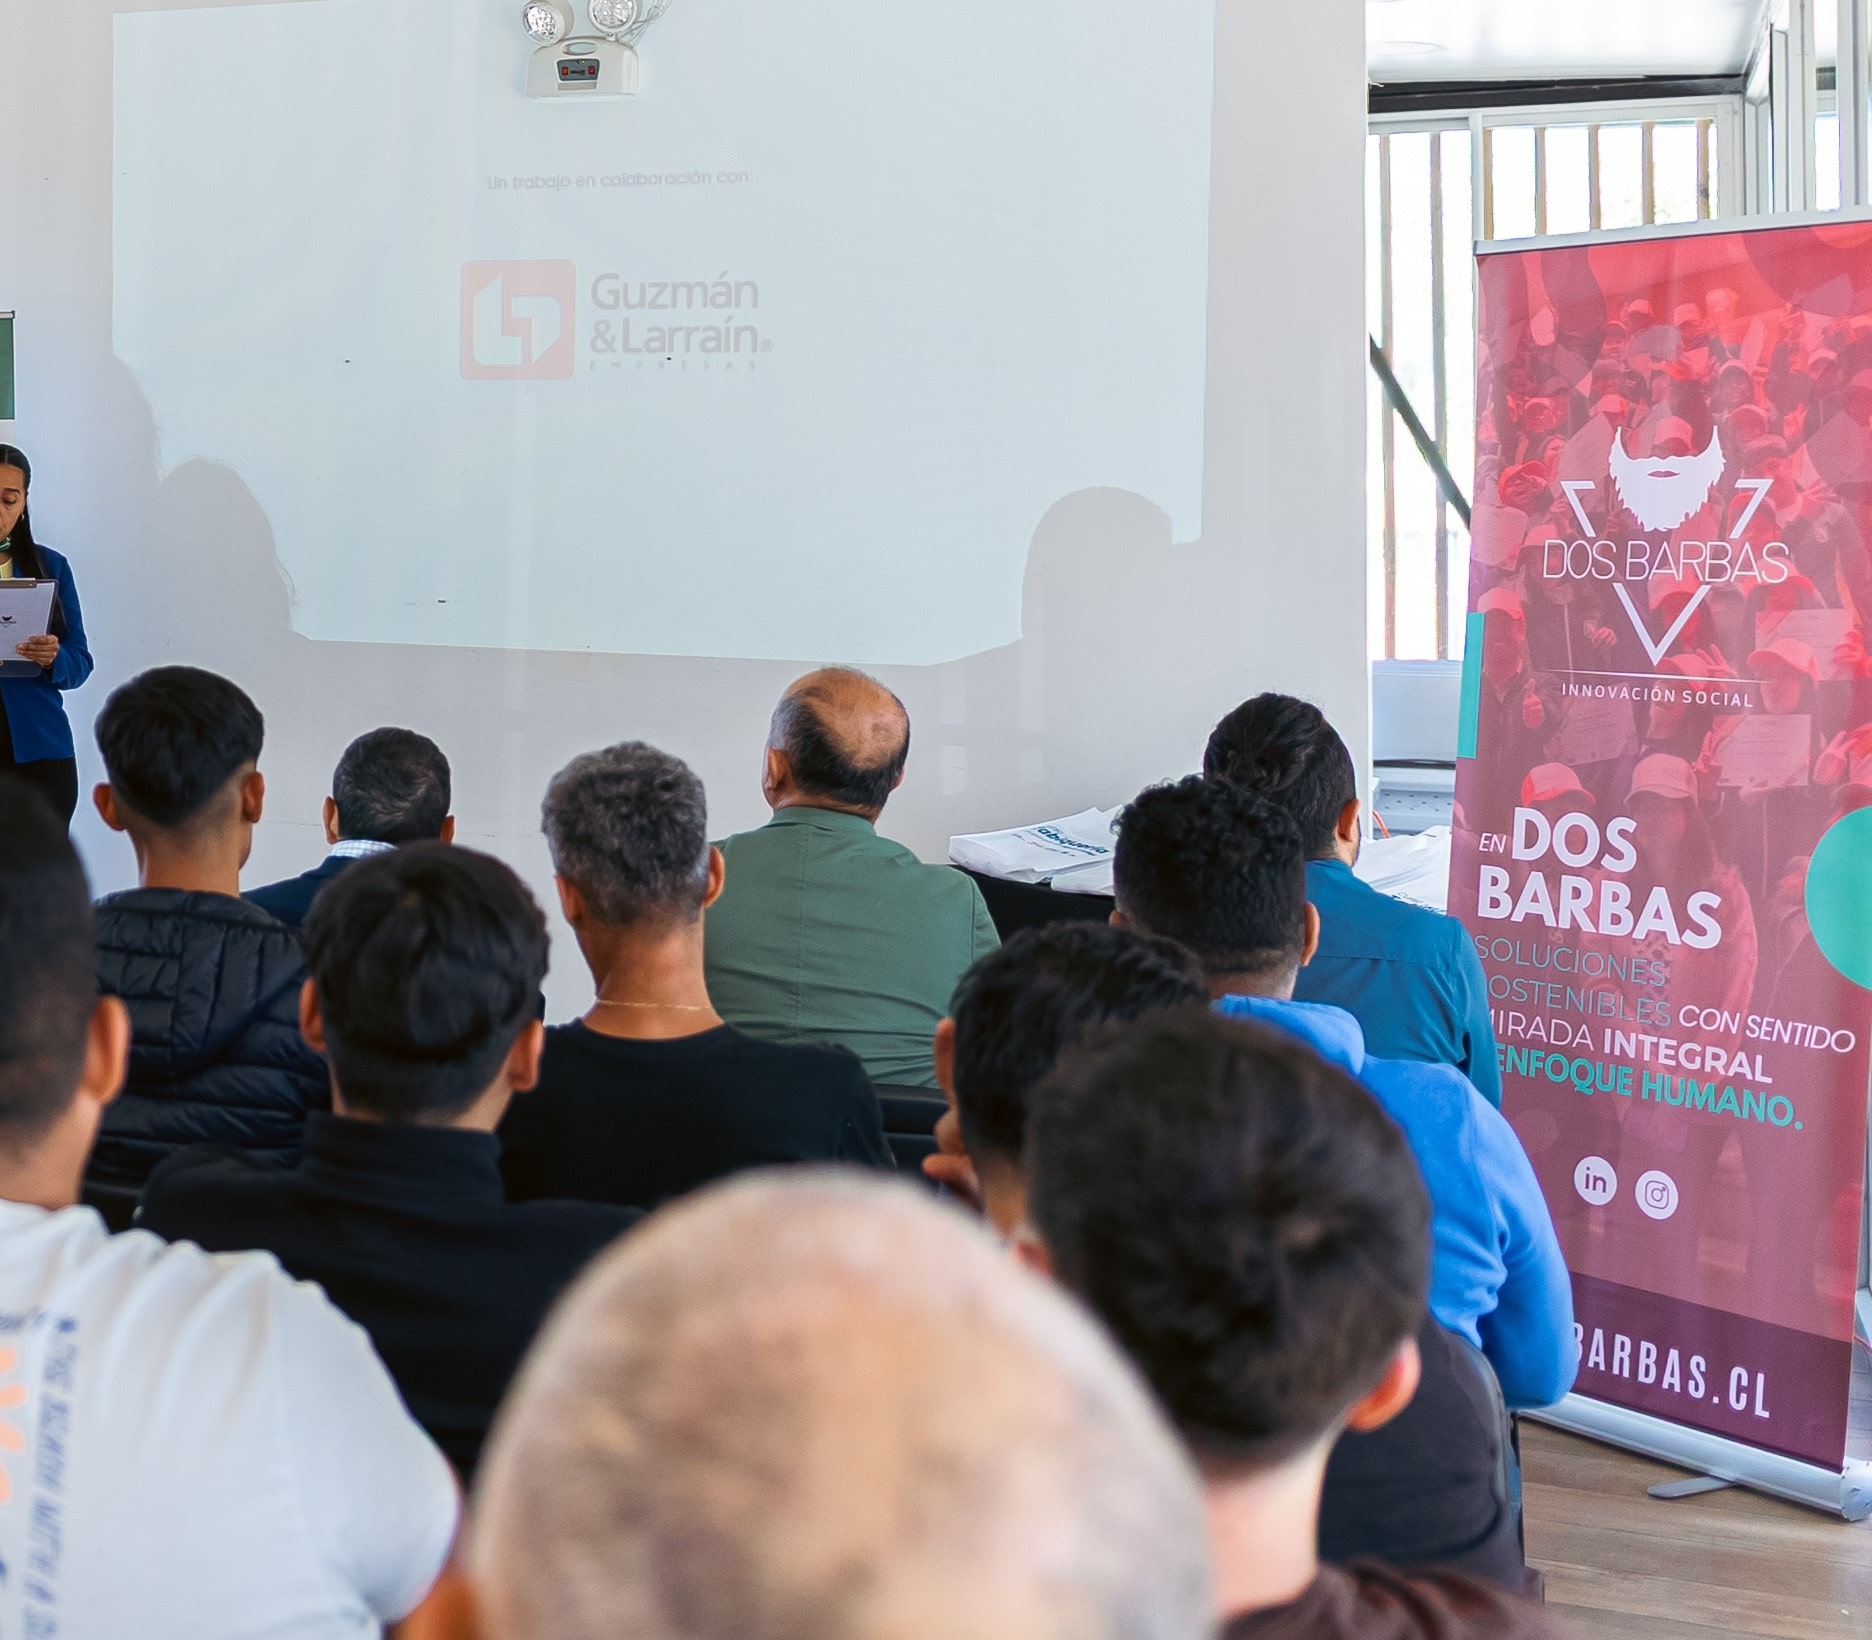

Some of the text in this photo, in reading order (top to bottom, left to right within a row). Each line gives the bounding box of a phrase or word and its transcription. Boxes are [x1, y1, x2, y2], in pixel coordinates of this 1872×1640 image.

[512, 174, 571, 194] trabajo
[575, 176, 596, 188] en
[590, 271, 759, 311] Guzmán
[1542, 539, 1790, 584] DOS BARBAS
[1562, 682, 1754, 708] INNOVACIÓN SOCIAL
[1479, 807, 1638, 873] EN DOS
[1477, 864, 1722, 950] BARBAS
[1474, 935, 1668, 988] SOLUCIONES
[1489, 974, 1856, 1053] OSTENIBLES CON SENTIDO
[1603, 1027, 1773, 1083] INTEGRAL
[1642, 1070, 1804, 1130] HUMANO.
